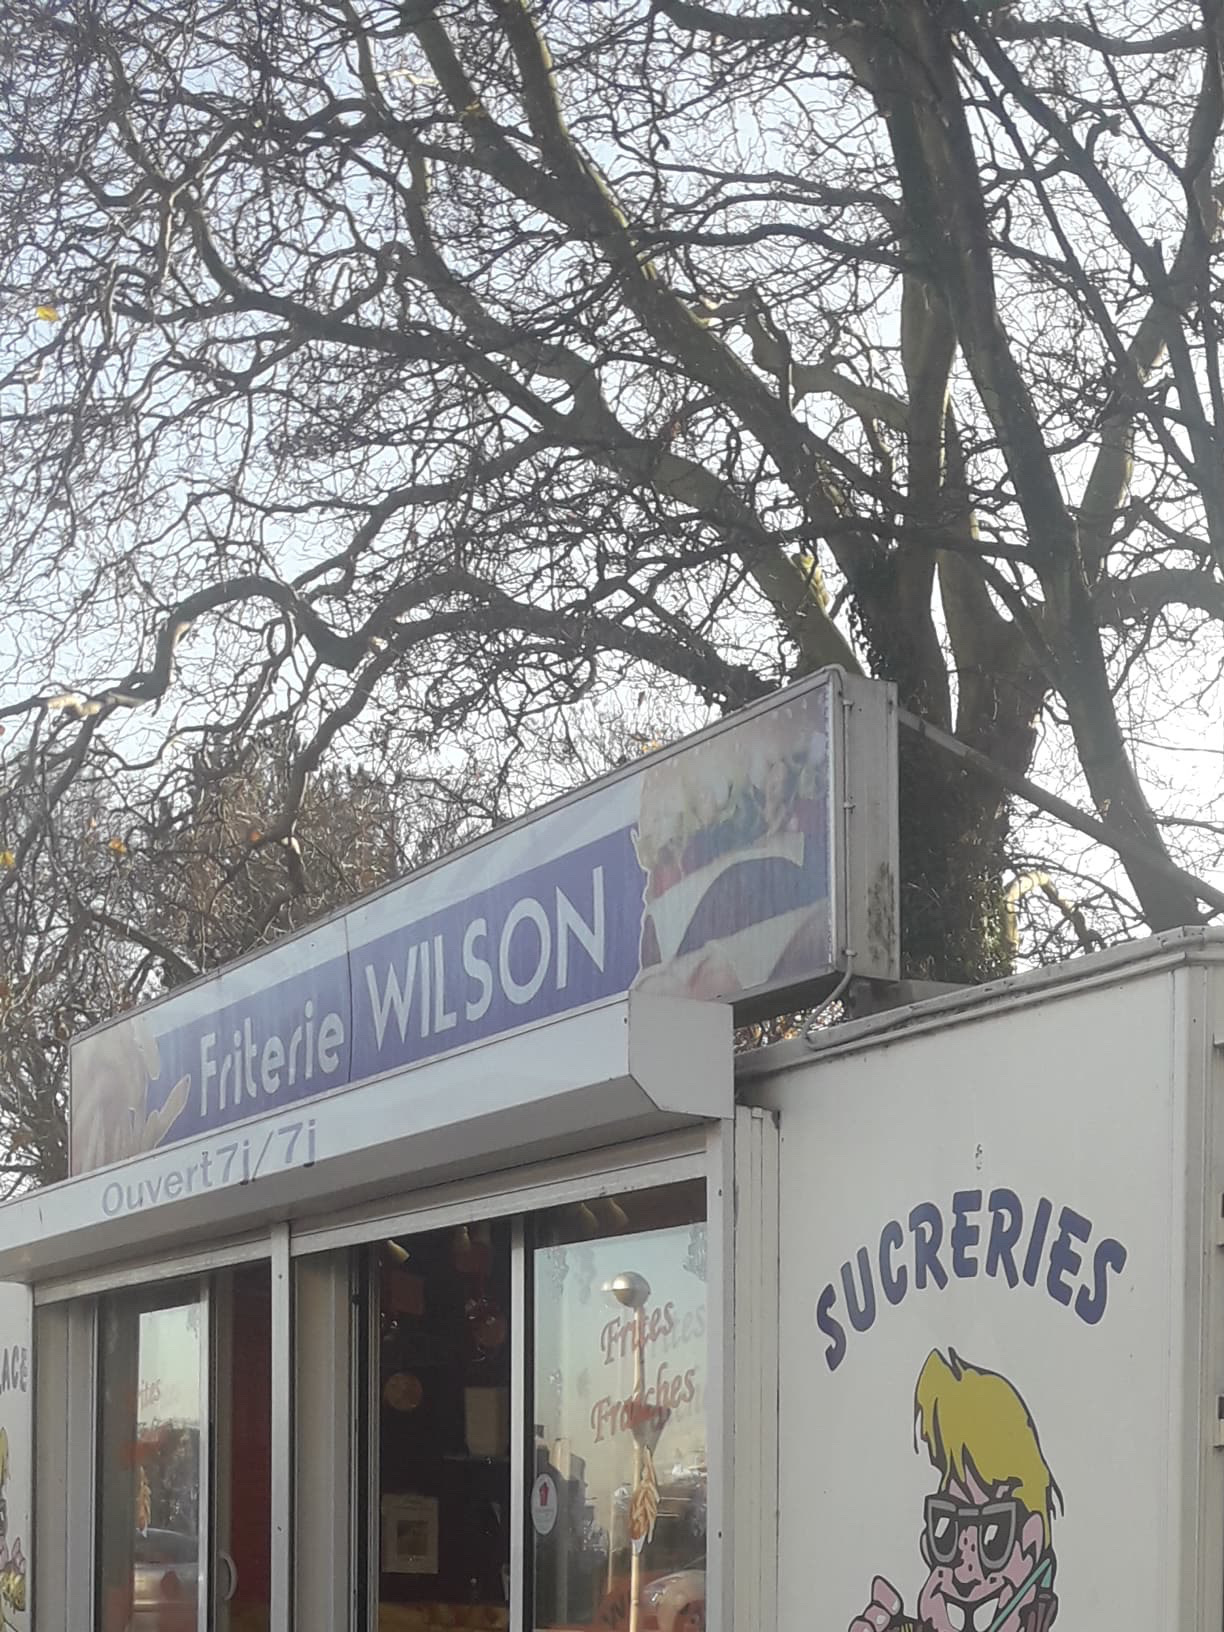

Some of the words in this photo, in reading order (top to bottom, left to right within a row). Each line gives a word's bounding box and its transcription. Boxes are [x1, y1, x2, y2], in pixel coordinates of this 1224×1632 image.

[200, 1000, 345, 1117] Friterie
[364, 865, 604, 1052] WILSON
[0, 1345, 28, 1394] ACE
[816, 1187, 1127, 1372] SUCRERIES
